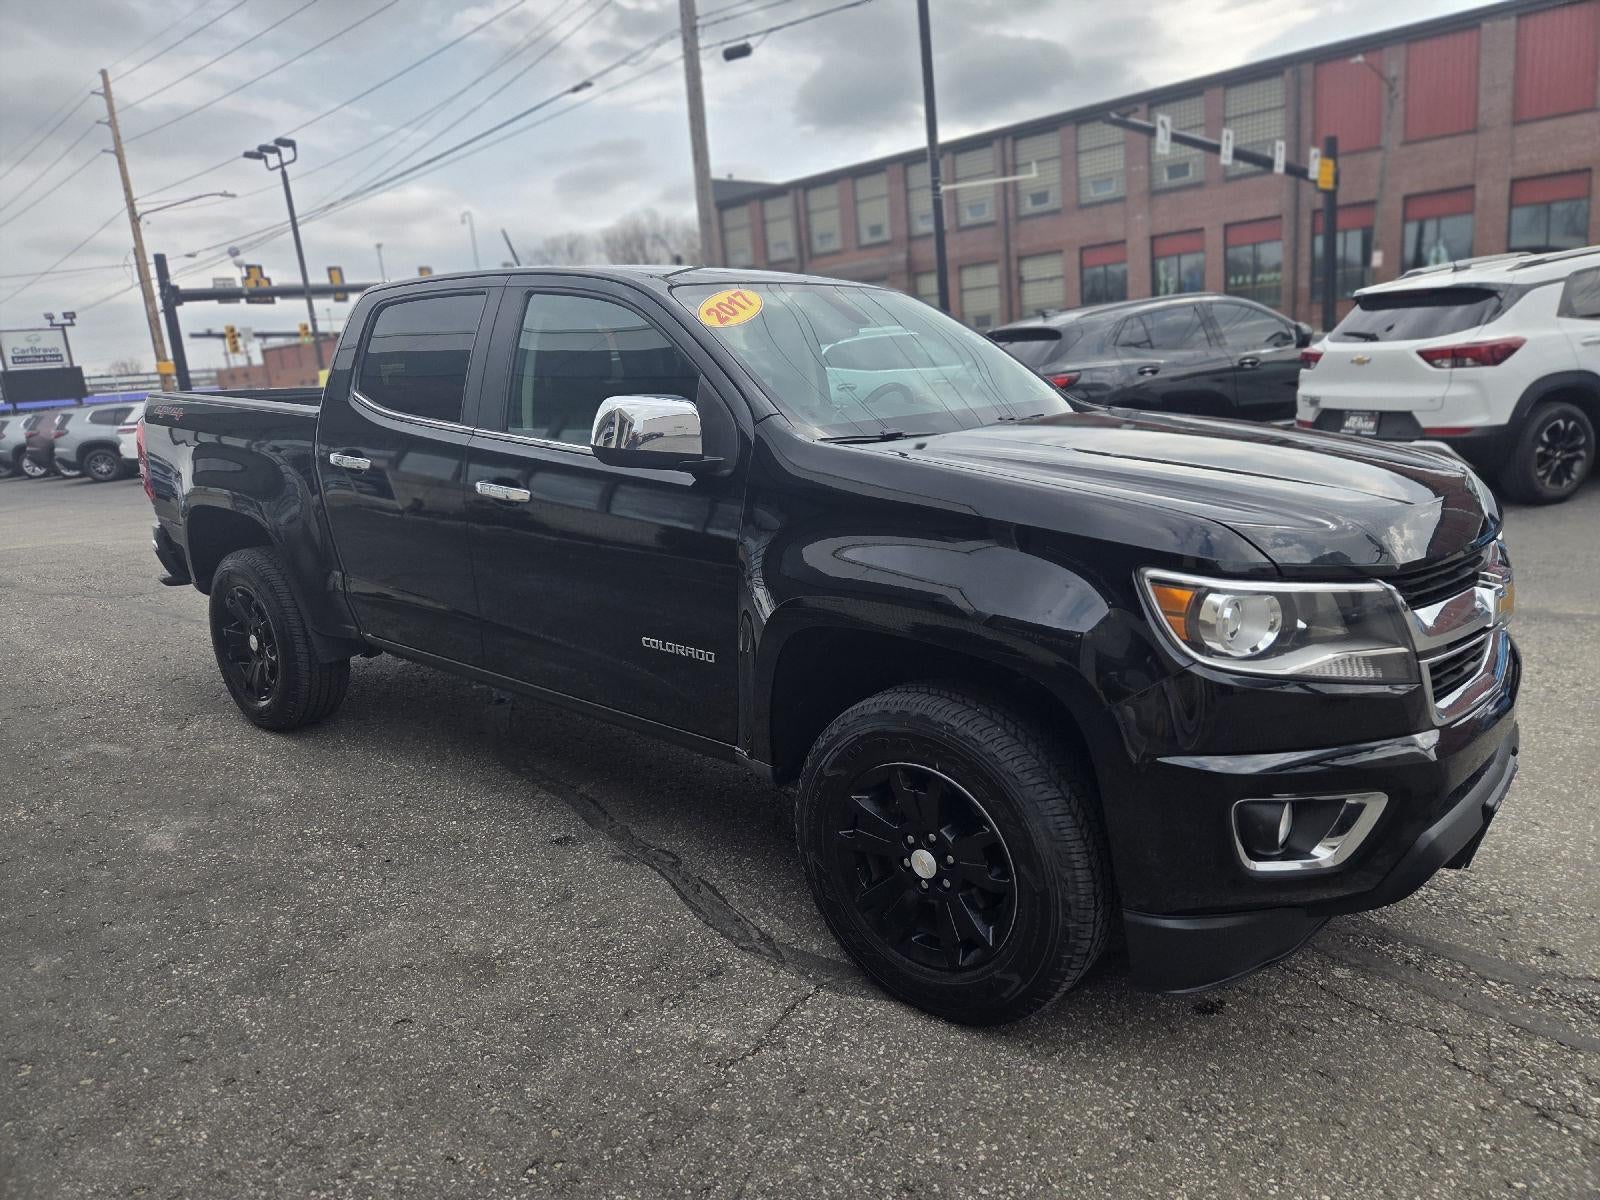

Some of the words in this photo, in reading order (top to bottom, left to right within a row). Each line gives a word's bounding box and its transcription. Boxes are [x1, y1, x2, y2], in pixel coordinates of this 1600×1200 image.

[705, 290, 754, 325] 2017
[11, 346, 60, 355] CarBravo
[641, 636, 715, 663] COLORADO
